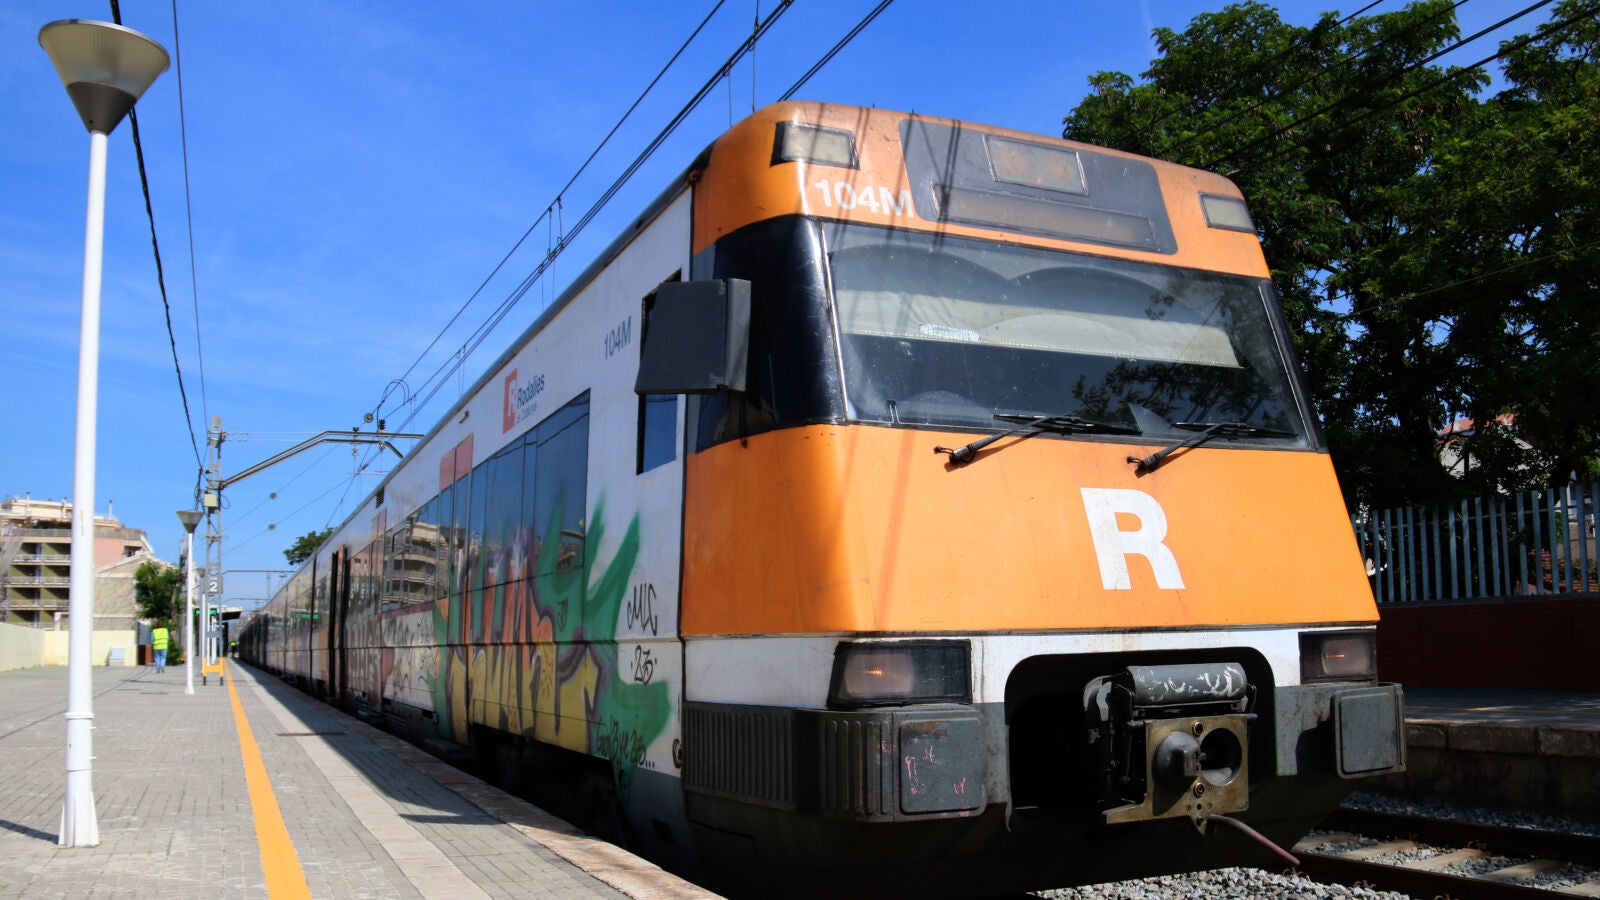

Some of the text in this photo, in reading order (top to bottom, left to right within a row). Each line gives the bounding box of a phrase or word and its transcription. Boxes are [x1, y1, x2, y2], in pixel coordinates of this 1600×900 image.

[815, 179, 915, 218] 104M
[603, 315, 632, 361] 104M
[516, 373, 545, 410] Rodalies
[1080, 487, 1187, 590] R
[209, 581, 218, 593] 2
